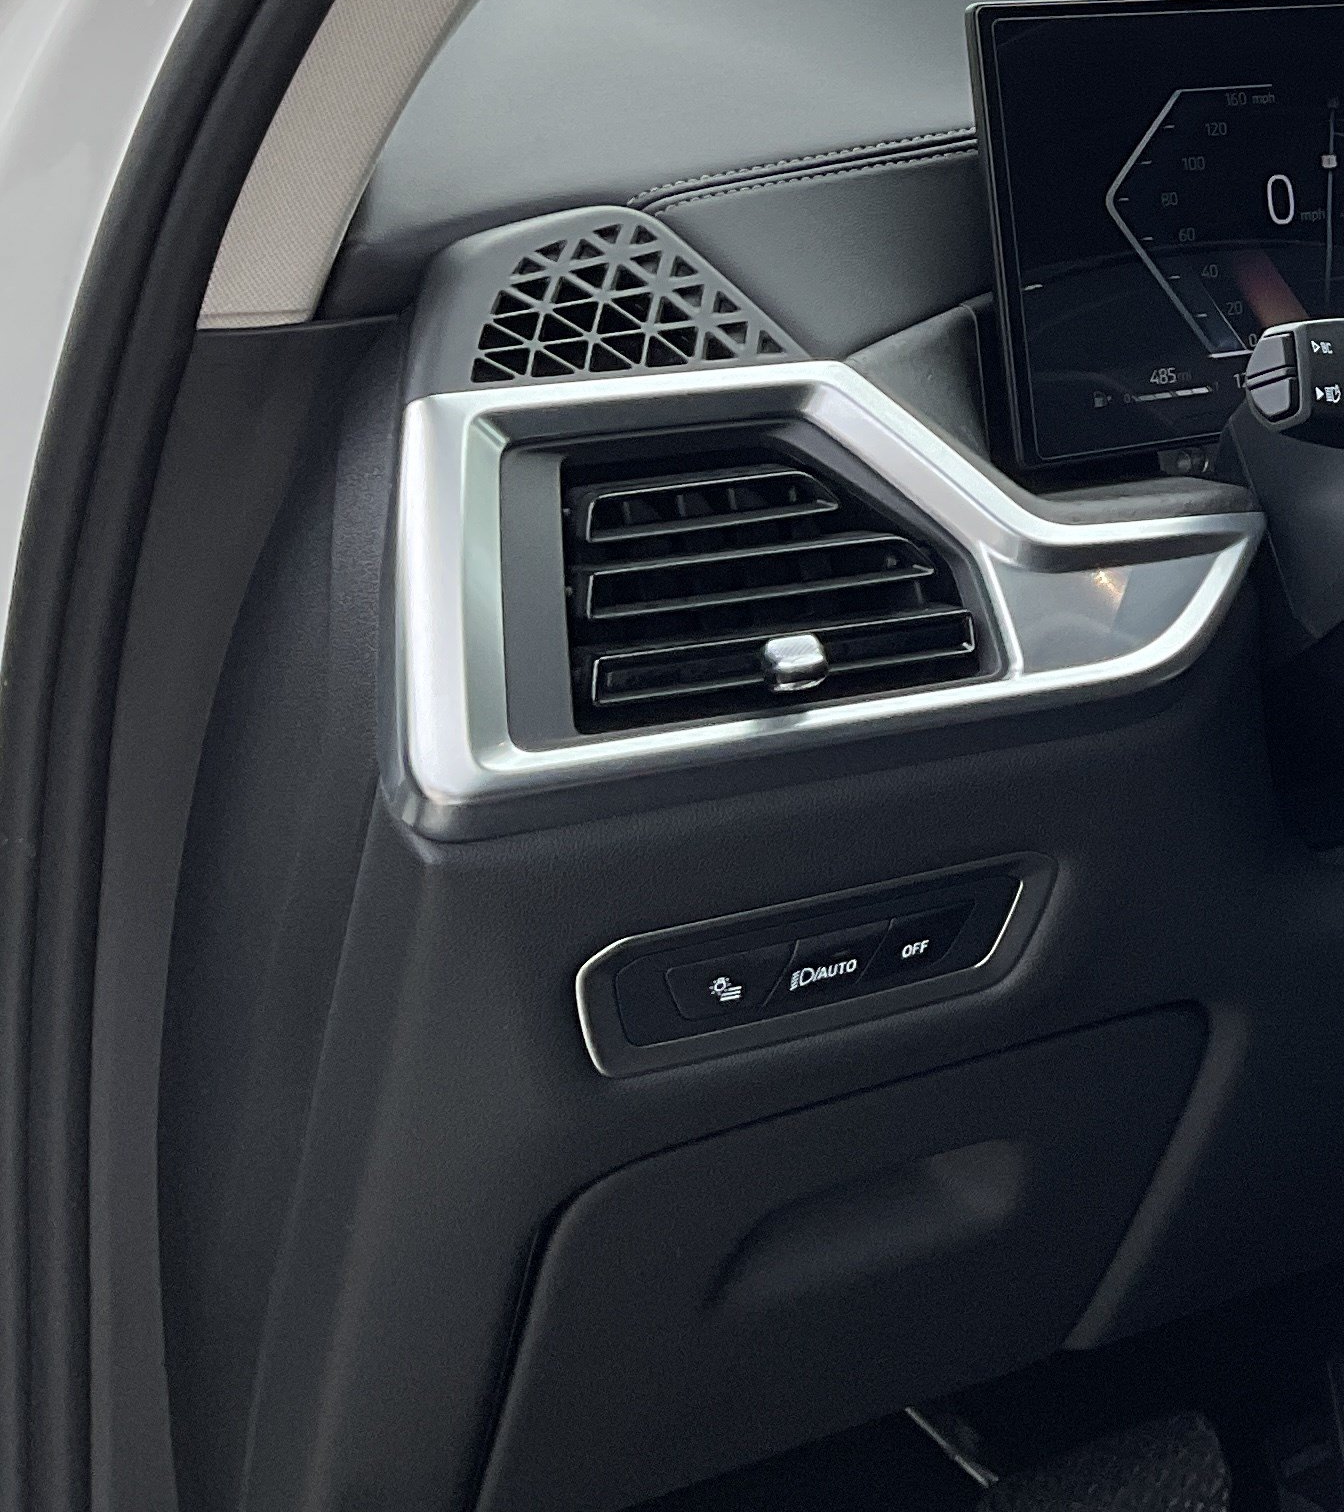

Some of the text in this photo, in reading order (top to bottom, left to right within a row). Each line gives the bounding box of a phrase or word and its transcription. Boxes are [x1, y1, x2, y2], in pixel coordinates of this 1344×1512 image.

[1252, 92, 1276, 105] mph
[1205, 121, 1228, 136] 120
[1182, 156, 1206, 171] 100
[1266, 174, 1326, 225] 0 mph
[1179, 227, 1196, 242] 60
[1202, 264, 1219, 278] 40
[1226, 300, 1243, 316] 20
[1150, 367, 1176, 385] 485
[902, 939, 929, 958] OFF
